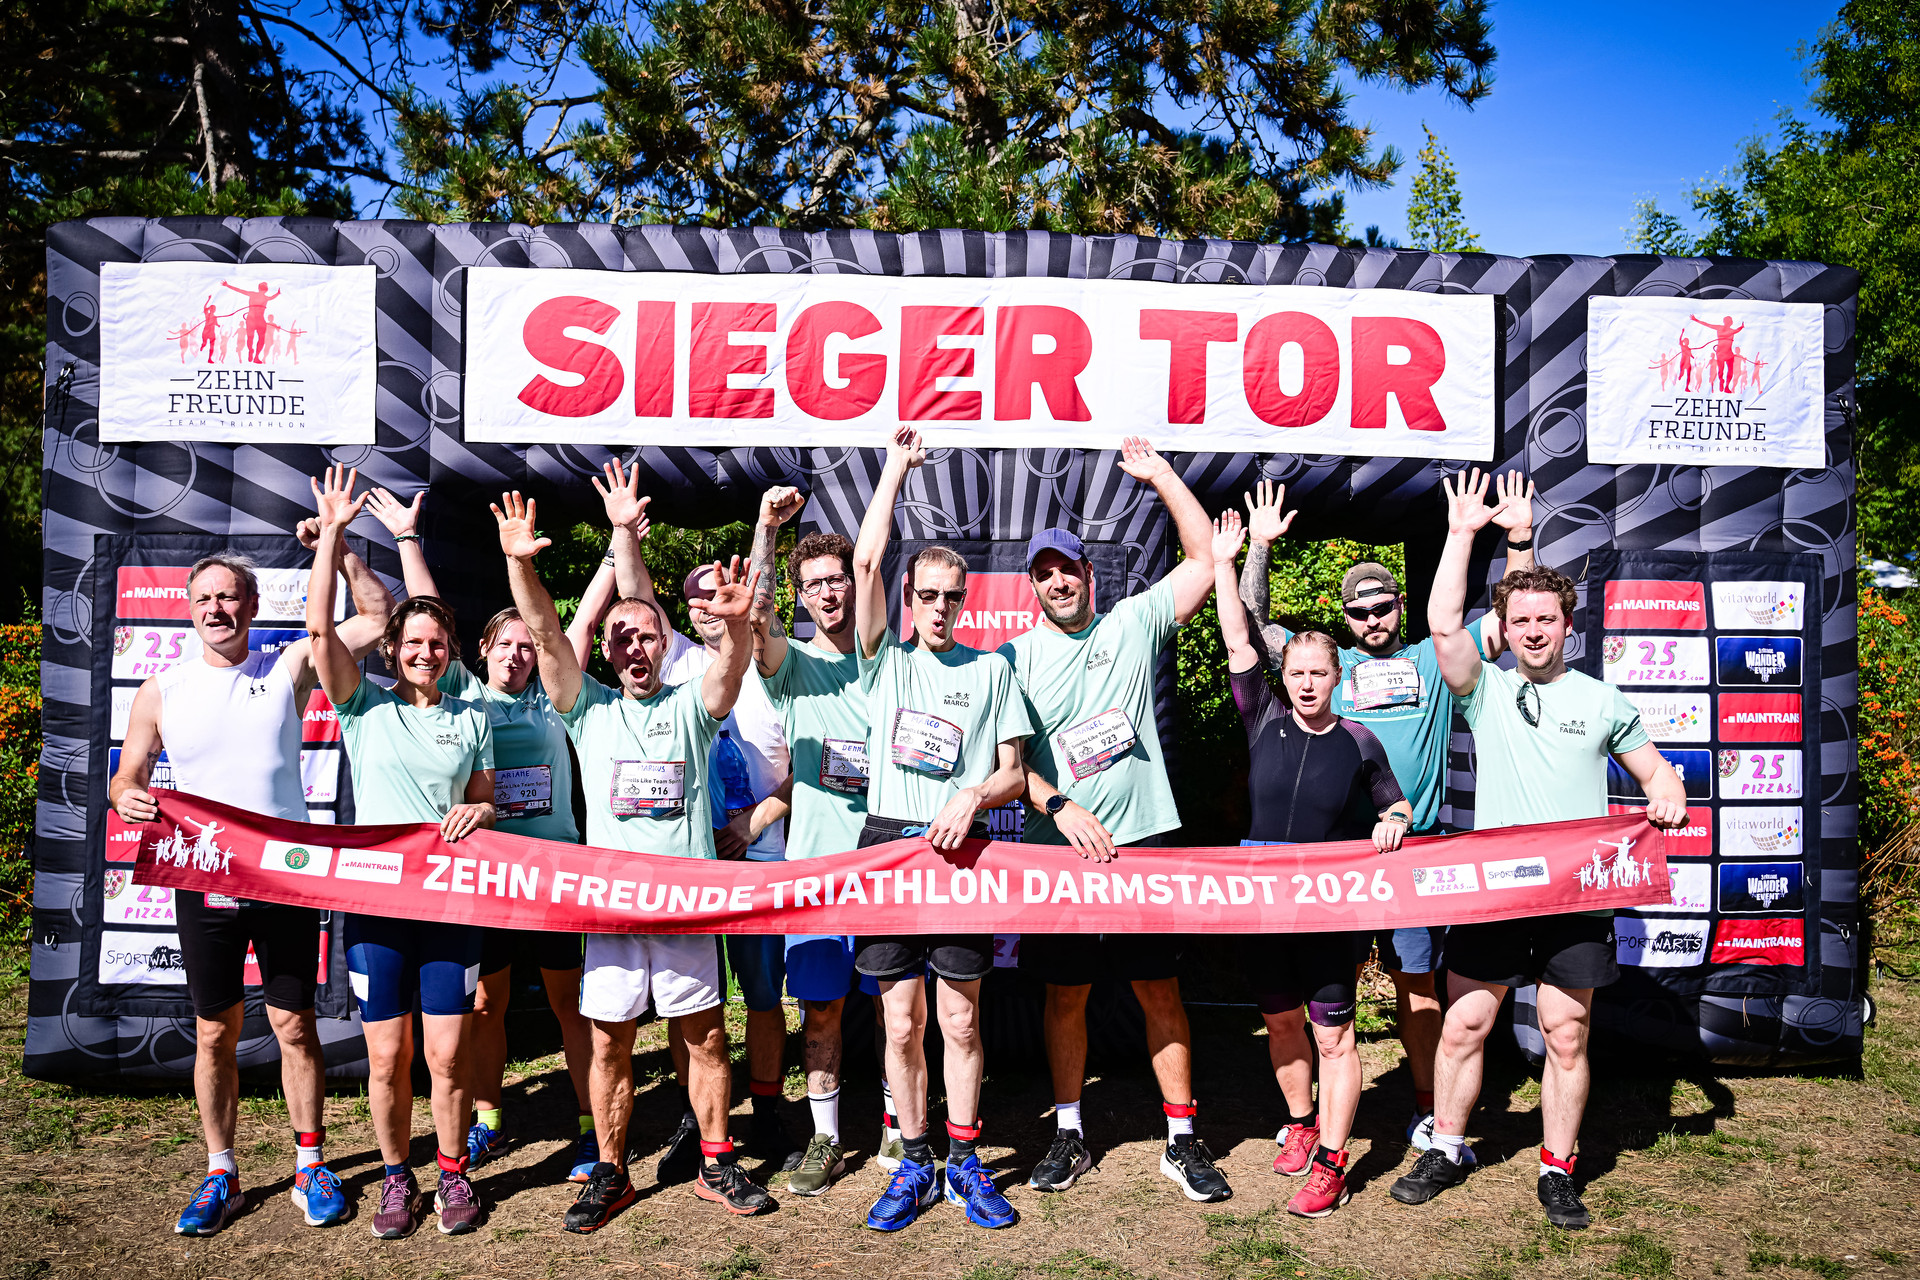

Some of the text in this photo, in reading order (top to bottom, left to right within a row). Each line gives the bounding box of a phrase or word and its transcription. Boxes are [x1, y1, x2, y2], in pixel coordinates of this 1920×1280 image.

[516, 295, 1446, 431] SIEGER TOR
[197, 370, 276, 390] ZEHN
[168, 394, 305, 415] FREUNDE
[1675, 398, 1743, 418] ZEHN
[220, 420, 306, 428] TRIATHLON
[1649, 420, 1767, 441] FREUNDE
[1692, 445, 1767, 453] TRIATHLON
[133, 587, 189, 599] MAINTR
[1719, 591, 1777, 604] vitaworld
[1622, 600, 1701, 611] MAINTRANS
[144, 631, 187, 659] 25
[1637, 640, 1678, 666] 25
[1745, 650, 1787, 668] WANDER
[1087, 657, 1112, 671] MARCEL
[1754, 666, 1778, 675] EVENT
[1387, 677, 1404, 685] 913
[943, 698, 970, 708] MARCO
[911, 715, 940, 729] MARCO
[1736, 713, 1801, 723] MAINTRANS
[647, 729, 673, 739] MARKUS
[1073, 719, 1105, 737] MARCEL
[1559, 726, 1586, 736] FABIAN
[899, 725, 916, 734] Smells
[917, 729, 928, 737] Like
[928, 732, 943, 742] Team
[943, 738, 957, 748] Spirit
[1071, 721, 1126, 750] Smells Like Team Spirit
[1100, 733, 1118, 747] 923
[435, 739, 461, 748] SOPHIE
[841, 744, 863, 752] DENN
[924, 740, 941, 754] 924
[859, 766, 870, 775] 91
[1750, 754, 1785, 780] 25
[640, 777, 652, 785] Like
[668, 778, 682, 786] Spirit
[520, 788, 537, 798] 920
[650, 786, 669, 796] 916
[1725, 817, 1784, 830] vitaworld
[349, 861, 399, 872] MAINTRANS
[1432, 867, 1457, 884] 25
[423, 854, 1395, 913] ZEHN FREUNDE TRIATHLON DARMSTADT 2026
[1747, 876, 1789, 895] WANDER
[1756, 892, 1780, 901] EVENT
[1617, 931, 1703, 950] PORTWÄRTS
[1732, 936, 1802, 949] MAINTRANS
[105, 946, 184, 966] SPORTWÄR
